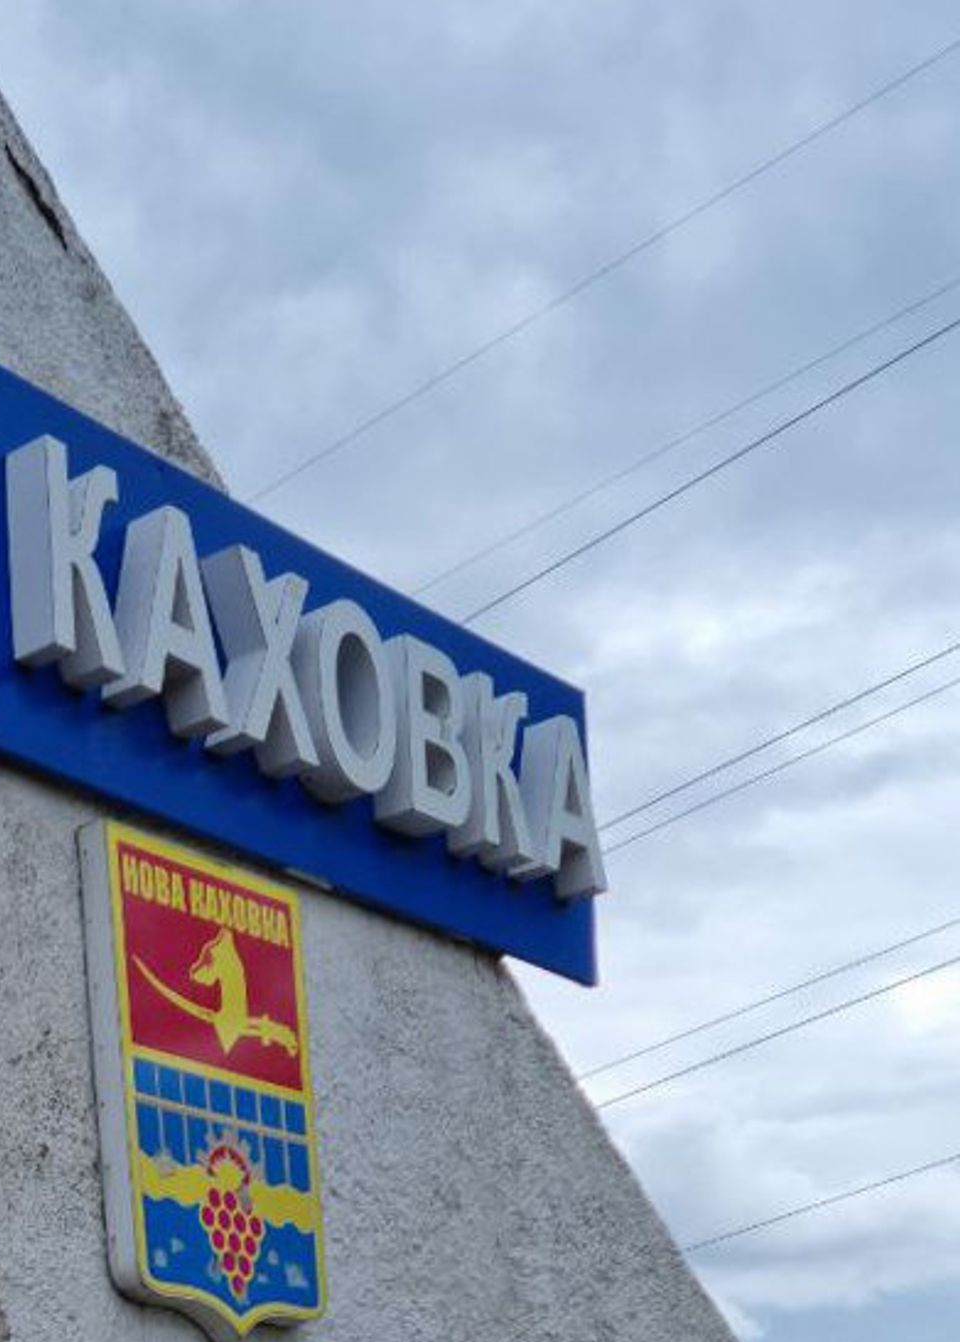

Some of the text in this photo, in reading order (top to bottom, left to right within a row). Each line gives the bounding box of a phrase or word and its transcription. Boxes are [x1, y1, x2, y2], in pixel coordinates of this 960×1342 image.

[5, 433, 608, 897] КАХОВКА
[122, 852, 291, 949] НОВА КАХОВКА
